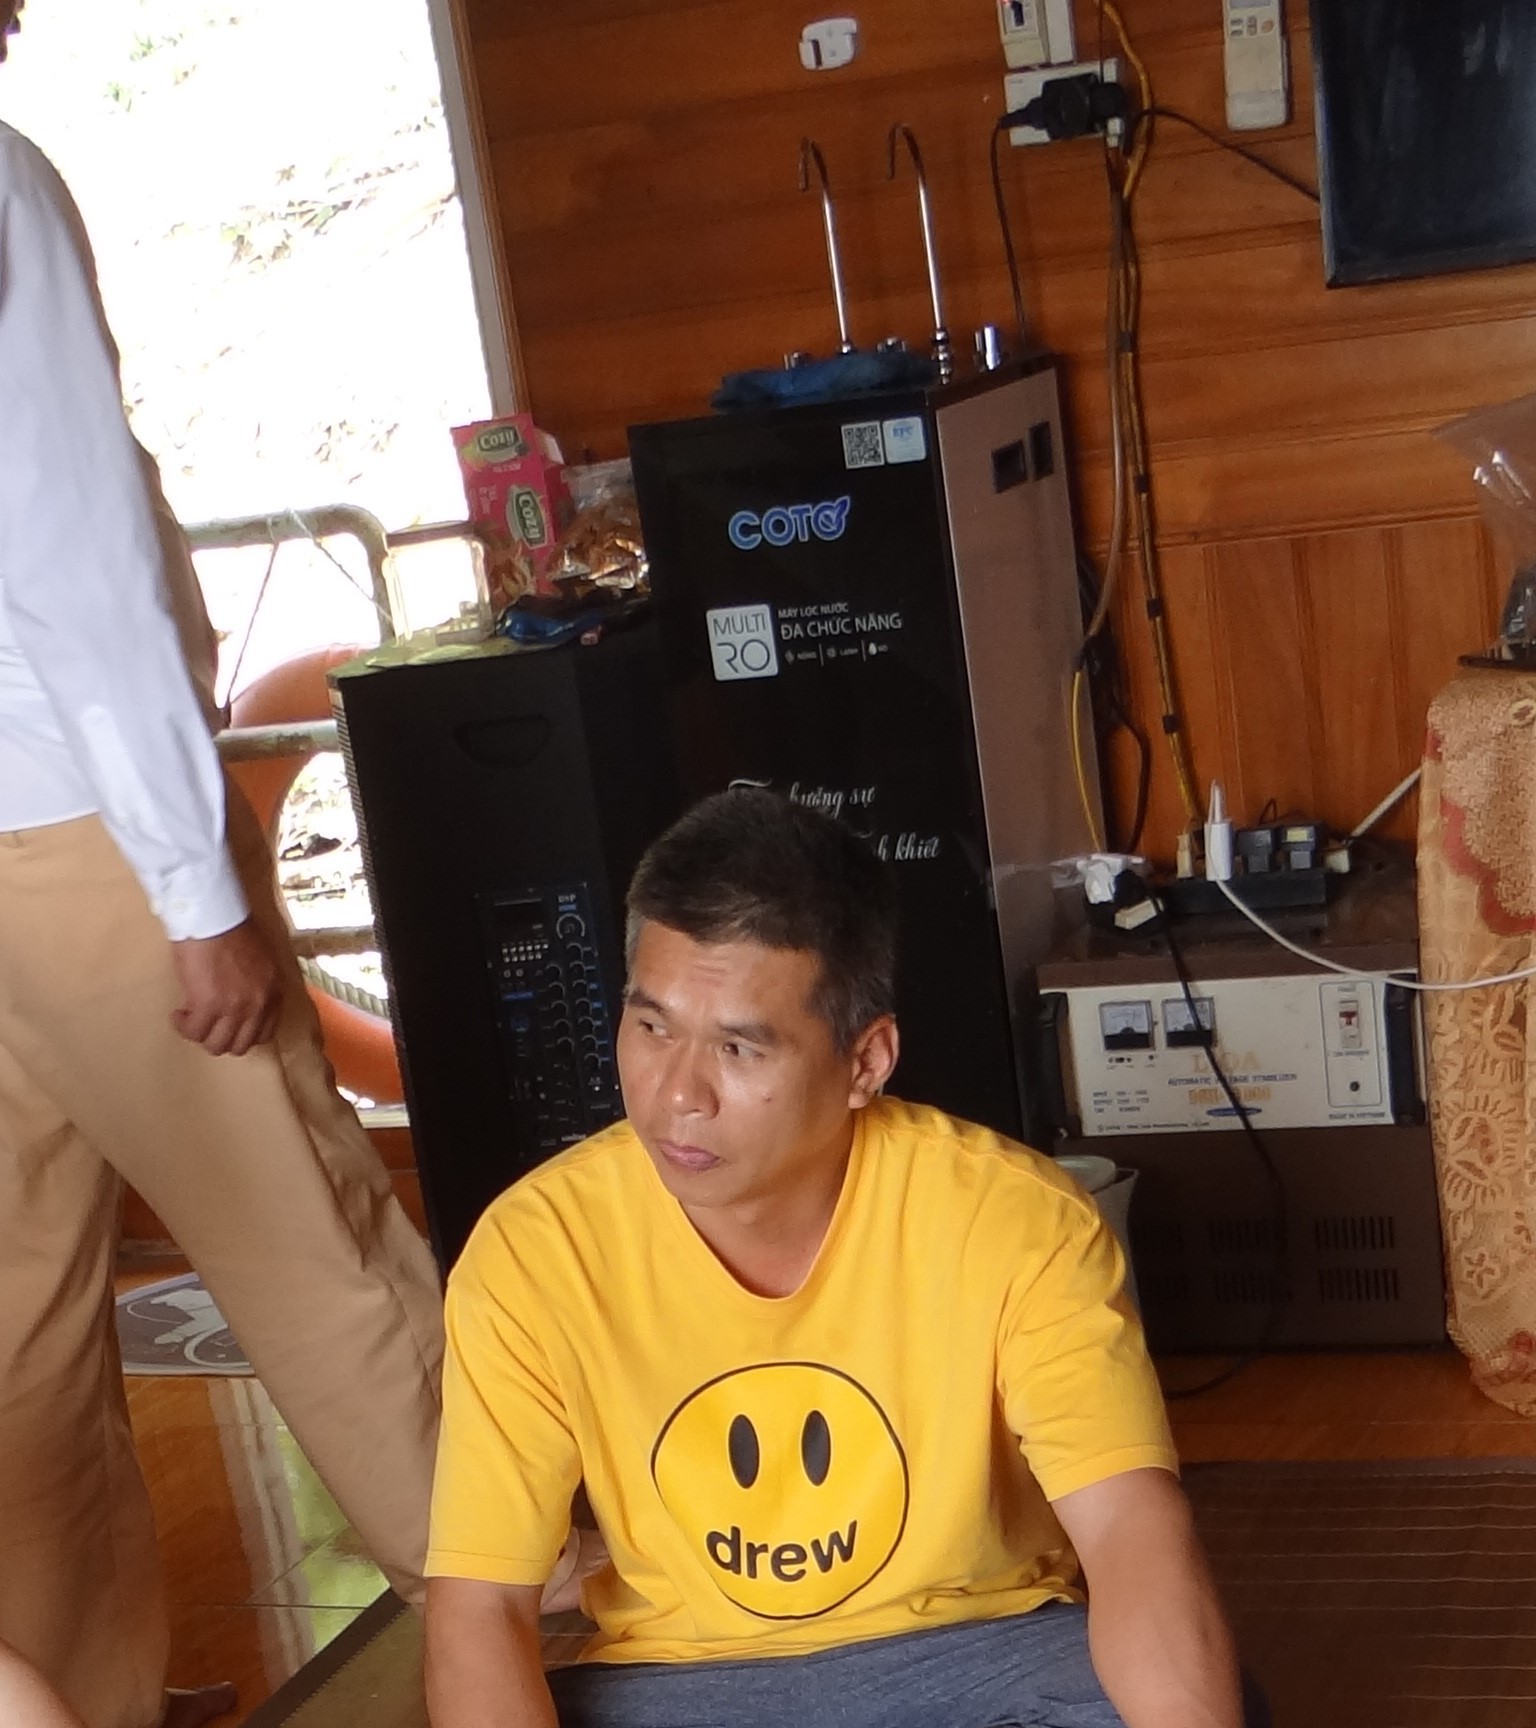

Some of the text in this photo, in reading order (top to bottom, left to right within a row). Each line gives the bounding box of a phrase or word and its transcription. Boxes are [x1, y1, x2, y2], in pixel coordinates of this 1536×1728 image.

[713, 612, 766, 637] MULTI
[780, 611, 902, 641] ĐA CHỨC NĂNG
[716, 639, 771, 674] RO
[706, 1519, 858, 1583] drew
